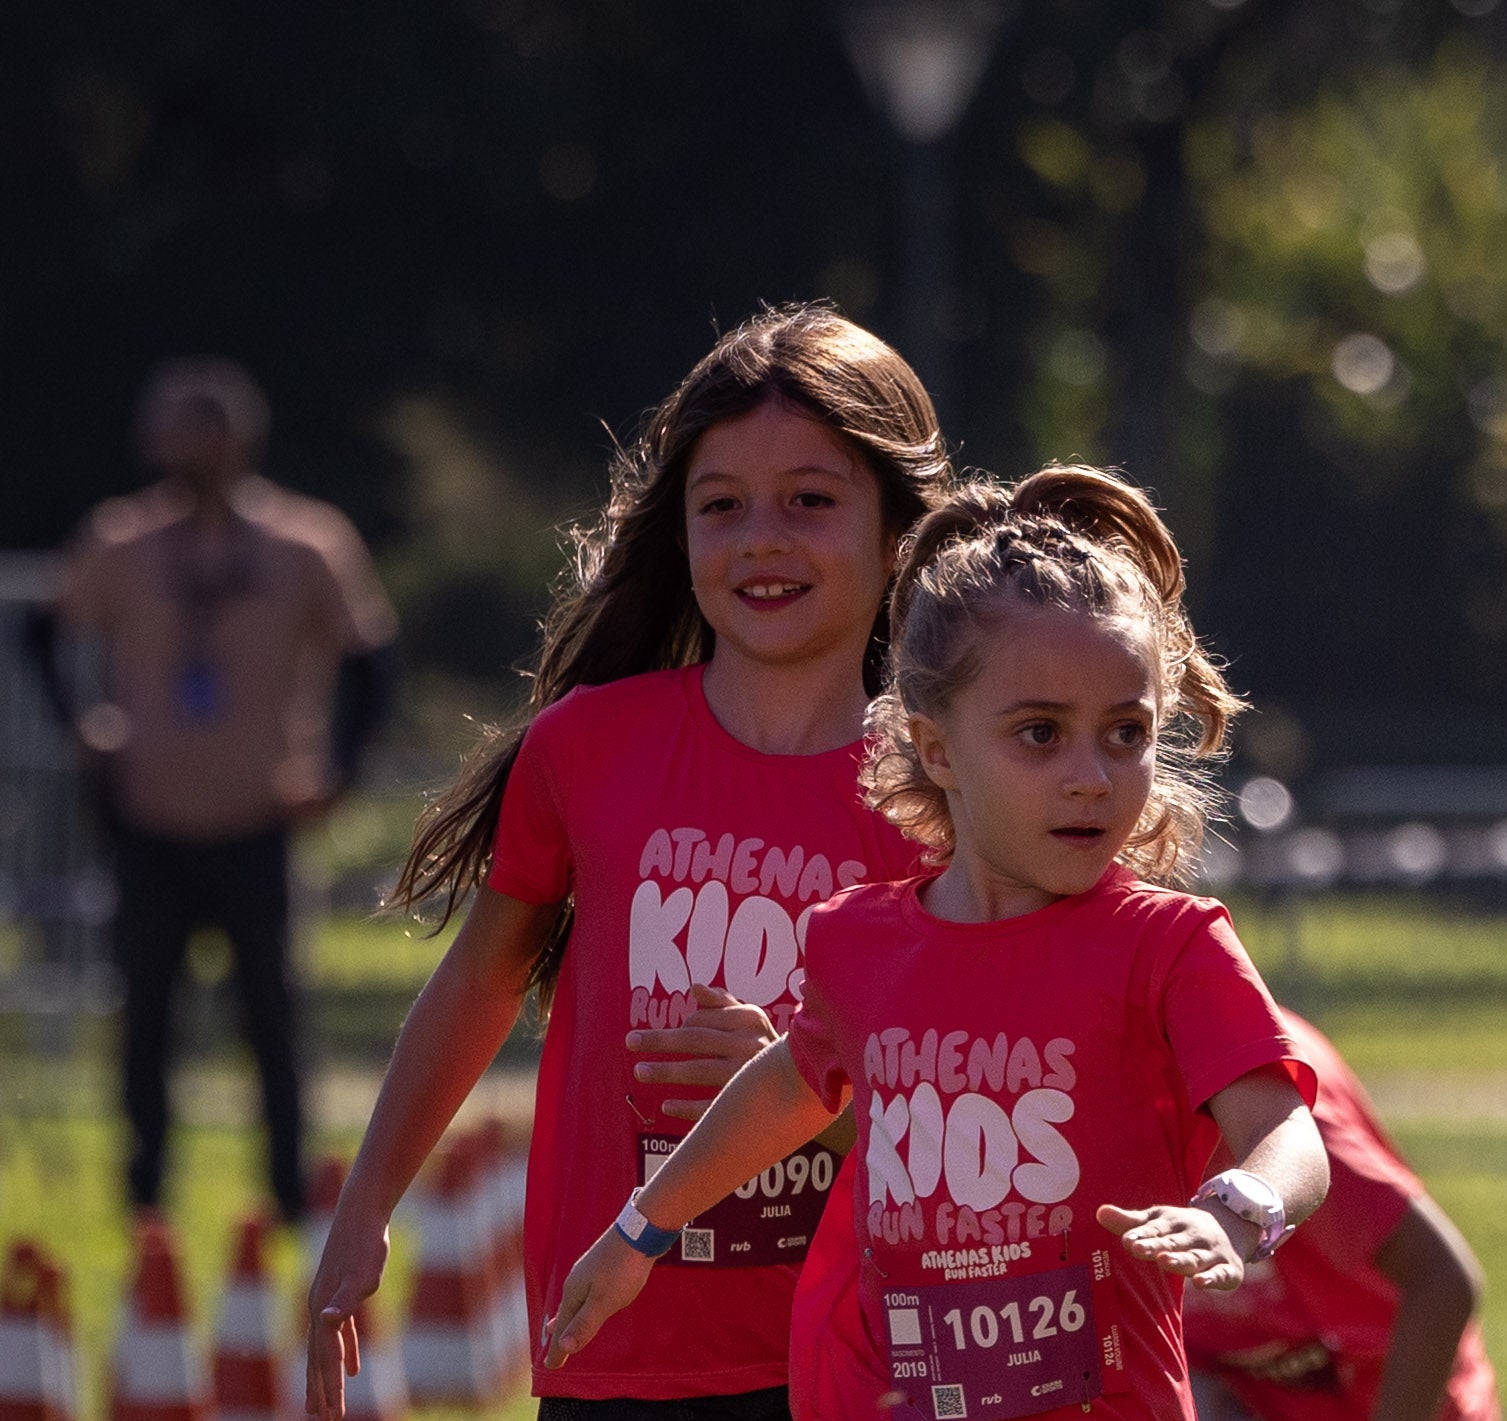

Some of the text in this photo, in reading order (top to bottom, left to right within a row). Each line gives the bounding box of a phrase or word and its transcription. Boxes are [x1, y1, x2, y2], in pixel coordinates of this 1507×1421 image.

[639, 827, 867, 902] ATHENAS
[629, 880, 805, 1007] KID
[864, 1027, 1077, 1093] ATHENAS
[866, 1081, 1080, 1212] KIDS
[760, 1205, 791, 1218] JULIA
[867, 1199, 1074, 1246] RUN FASTER
[730, 1241, 751, 1252] rvb
[921, 1242, 1032, 1270] ATHENAS KIDS
[945, 1263, 1008, 1281] RUN FASTER
[1091, 1250, 1105, 1281] 10126
[883, 1293, 920, 1306] 100m
[943, 1289, 1085, 1351] 10126
[1007, 1350, 1042, 1367] JULIA
[1102, 1335, 1115, 1366] 10126
[893, 1361, 927, 1378] 2019
[981, 1394, 1002, 1406] rvb
